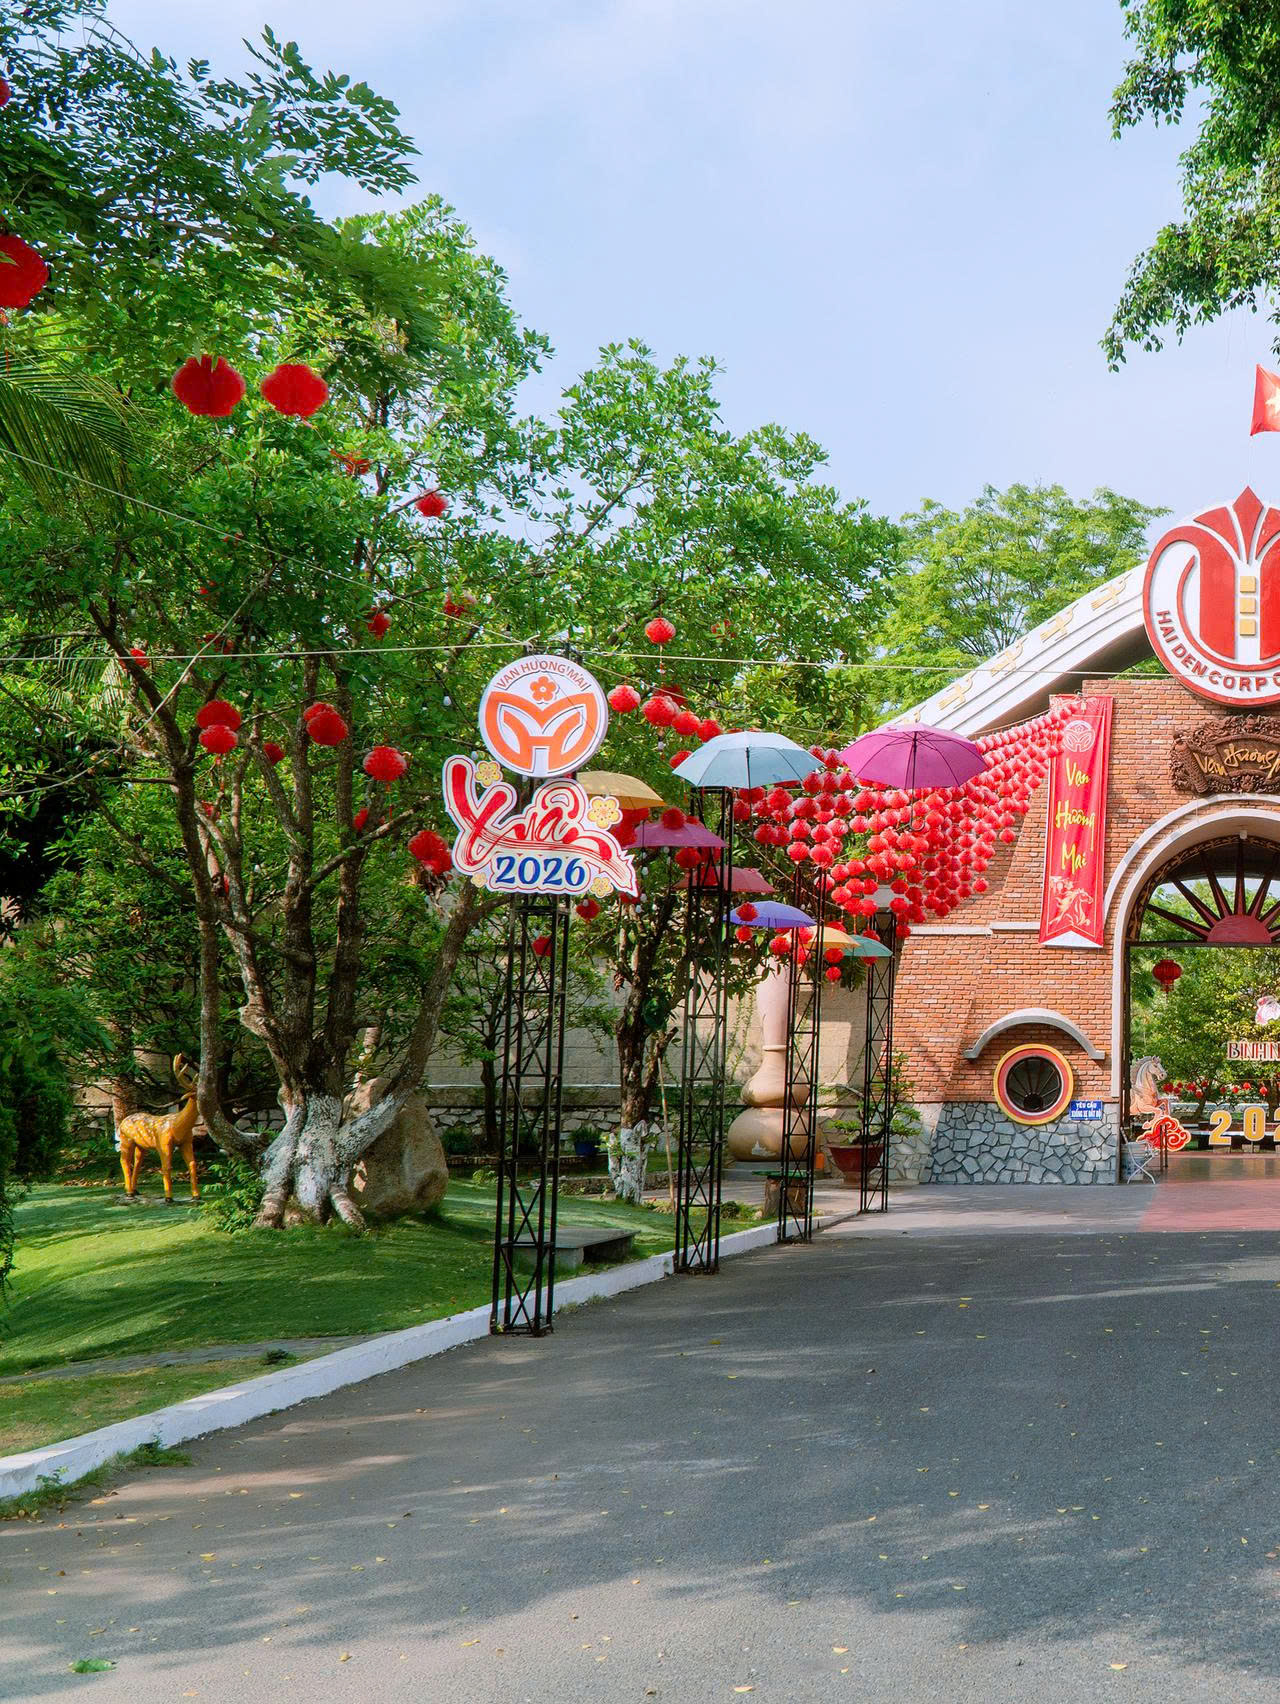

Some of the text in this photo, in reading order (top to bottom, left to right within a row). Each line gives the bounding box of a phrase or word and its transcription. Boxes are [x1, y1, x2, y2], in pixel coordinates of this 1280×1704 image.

[1156, 610, 1178, 644] HAI
[497, 667, 521, 688] VAN
[495, 856, 586, 887] 2026
[1061, 841, 1088, 875] Mai
